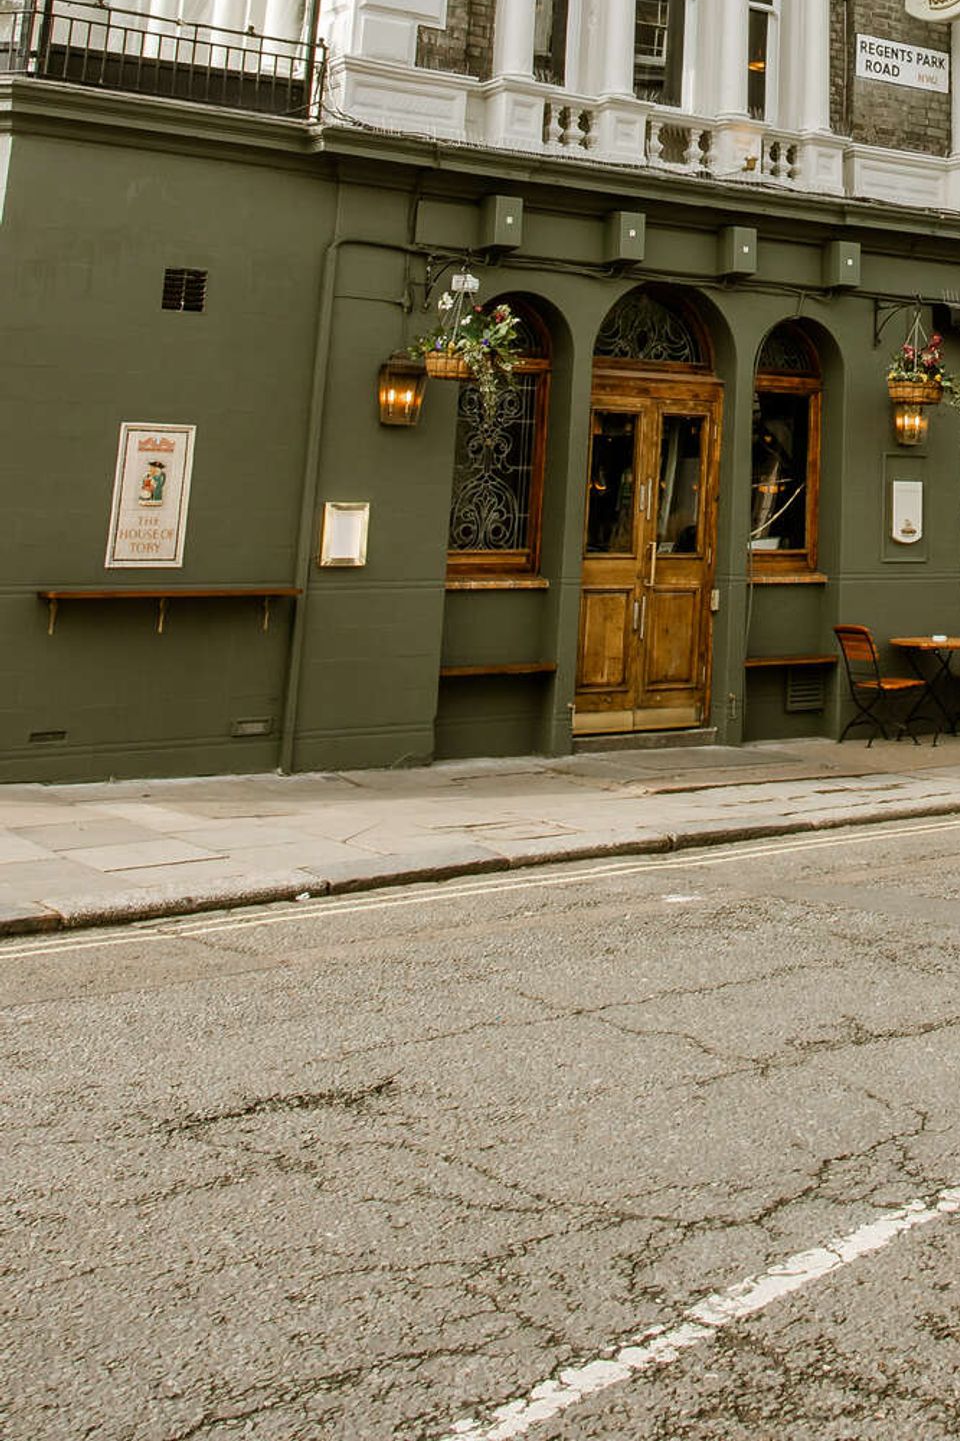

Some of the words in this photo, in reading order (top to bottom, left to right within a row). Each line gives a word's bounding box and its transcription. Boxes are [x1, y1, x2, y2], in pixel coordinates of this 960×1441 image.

[860, 40, 913, 63] REGENTS
[916, 52, 946, 70] PARK
[865, 59, 900, 77] ROAD
[138, 516, 160, 526] THE
[119, 528, 160, 540] HOUSE
